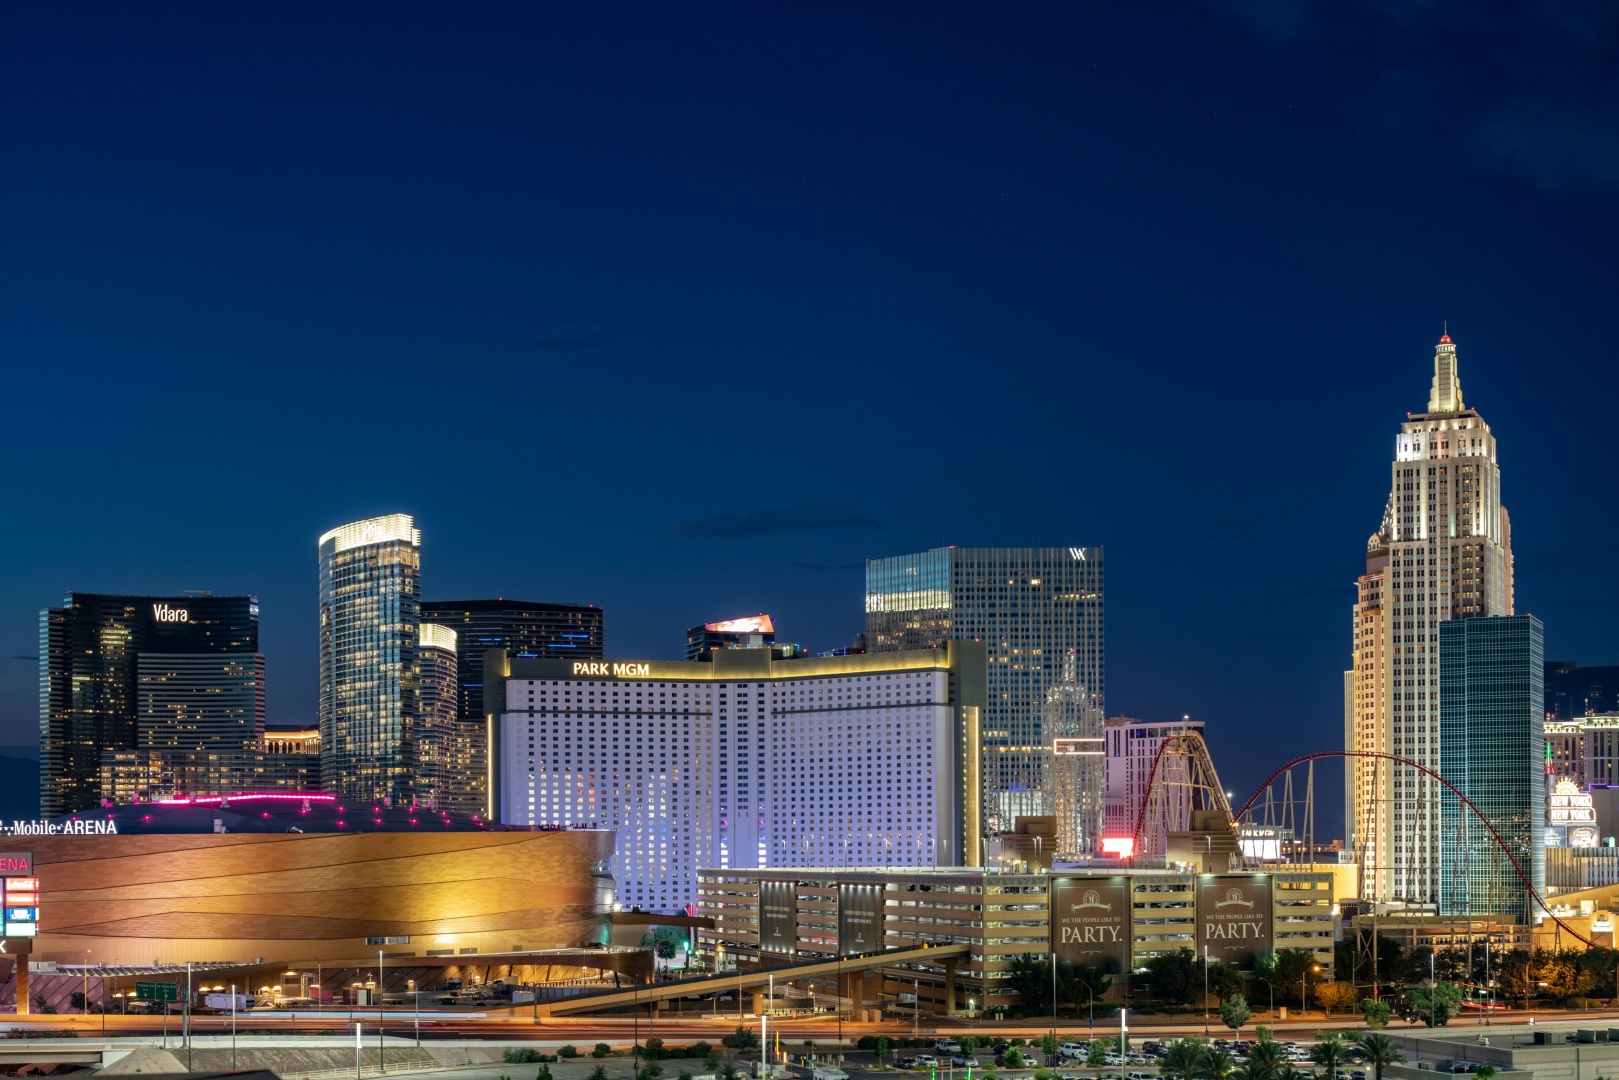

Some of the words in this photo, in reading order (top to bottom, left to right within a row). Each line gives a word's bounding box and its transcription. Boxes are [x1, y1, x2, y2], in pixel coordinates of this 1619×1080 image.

[153, 604, 187, 622] Vdara
[573, 662, 609, 675] PARK
[613, 663, 649, 676] MGM
[1551, 795, 1569, 807] NEW
[1569, 795, 1590, 807] YORK
[1551, 809, 1569, 820] NEW
[1569, 809, 1591, 820] YORK
[63, 820, 118, 835] ARENA
[1061, 925, 1122, 944] PARTY.
[1205, 922, 1265, 939] PARTY.
